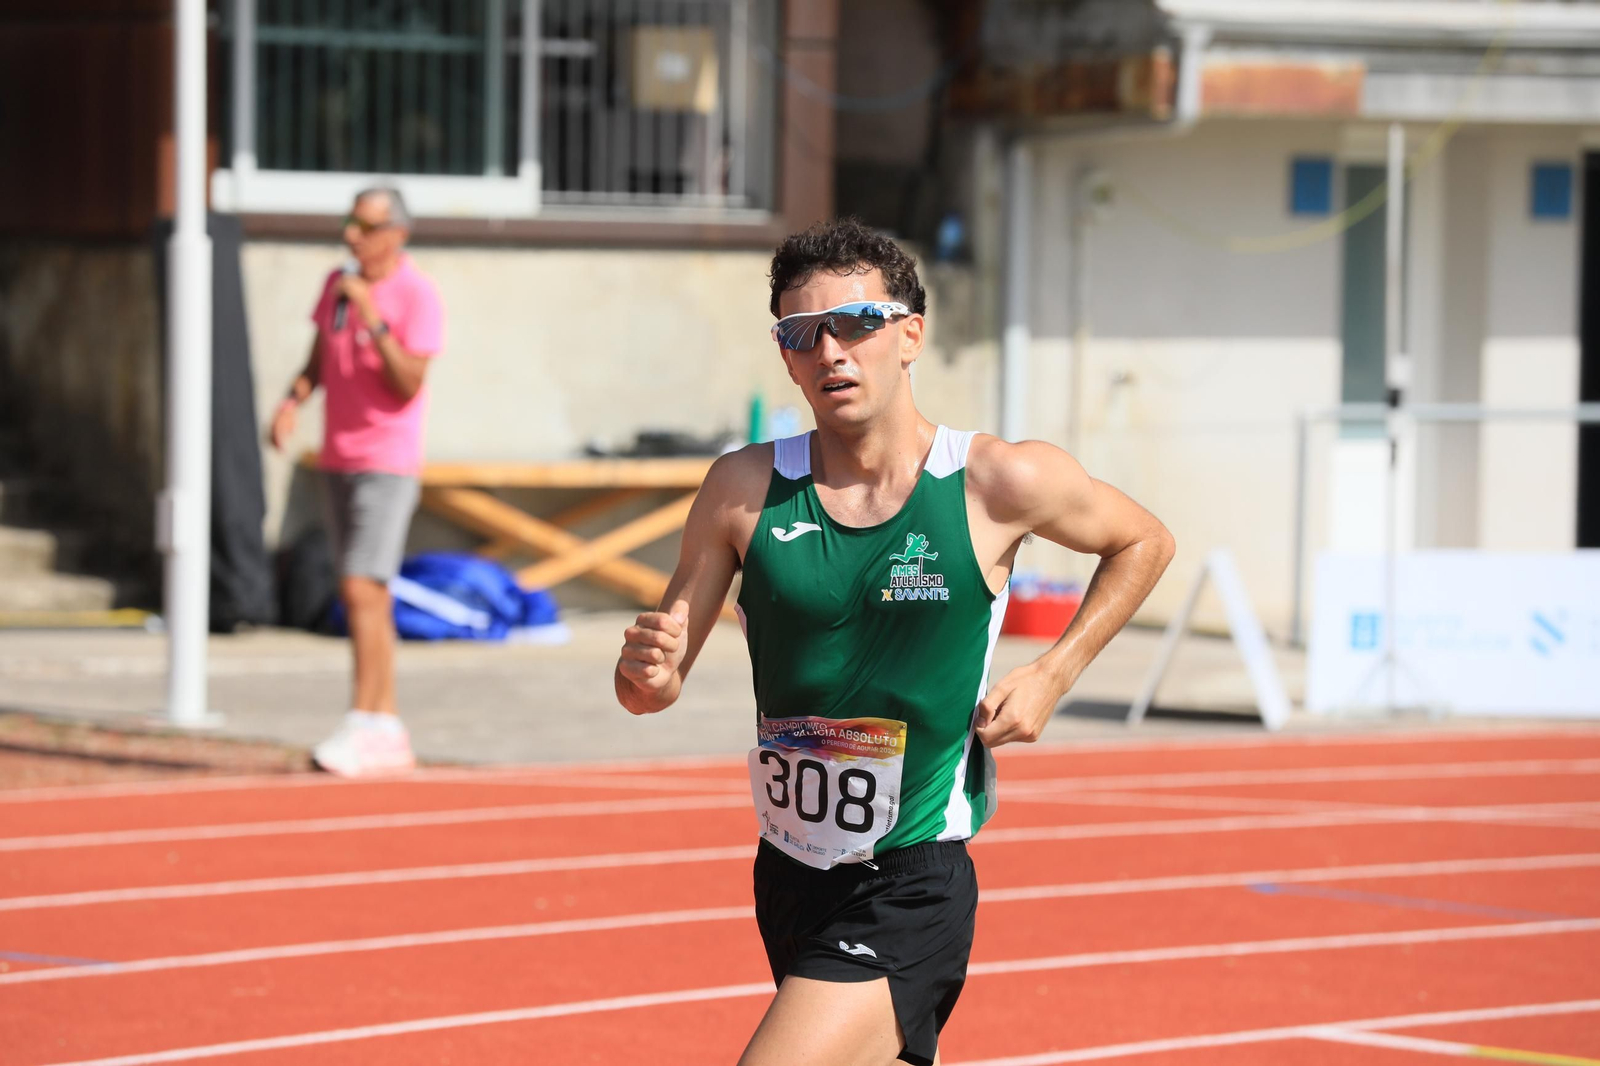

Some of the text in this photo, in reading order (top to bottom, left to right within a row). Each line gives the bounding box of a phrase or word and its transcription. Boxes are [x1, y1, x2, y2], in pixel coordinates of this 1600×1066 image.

[891, 565, 919, 576] AMES
[890, 574, 944, 588] ATLETISMO
[894, 587, 950, 601] SAVANTE
[838, 728, 897, 747] ABSOLUTO
[759, 750, 877, 834] 308
